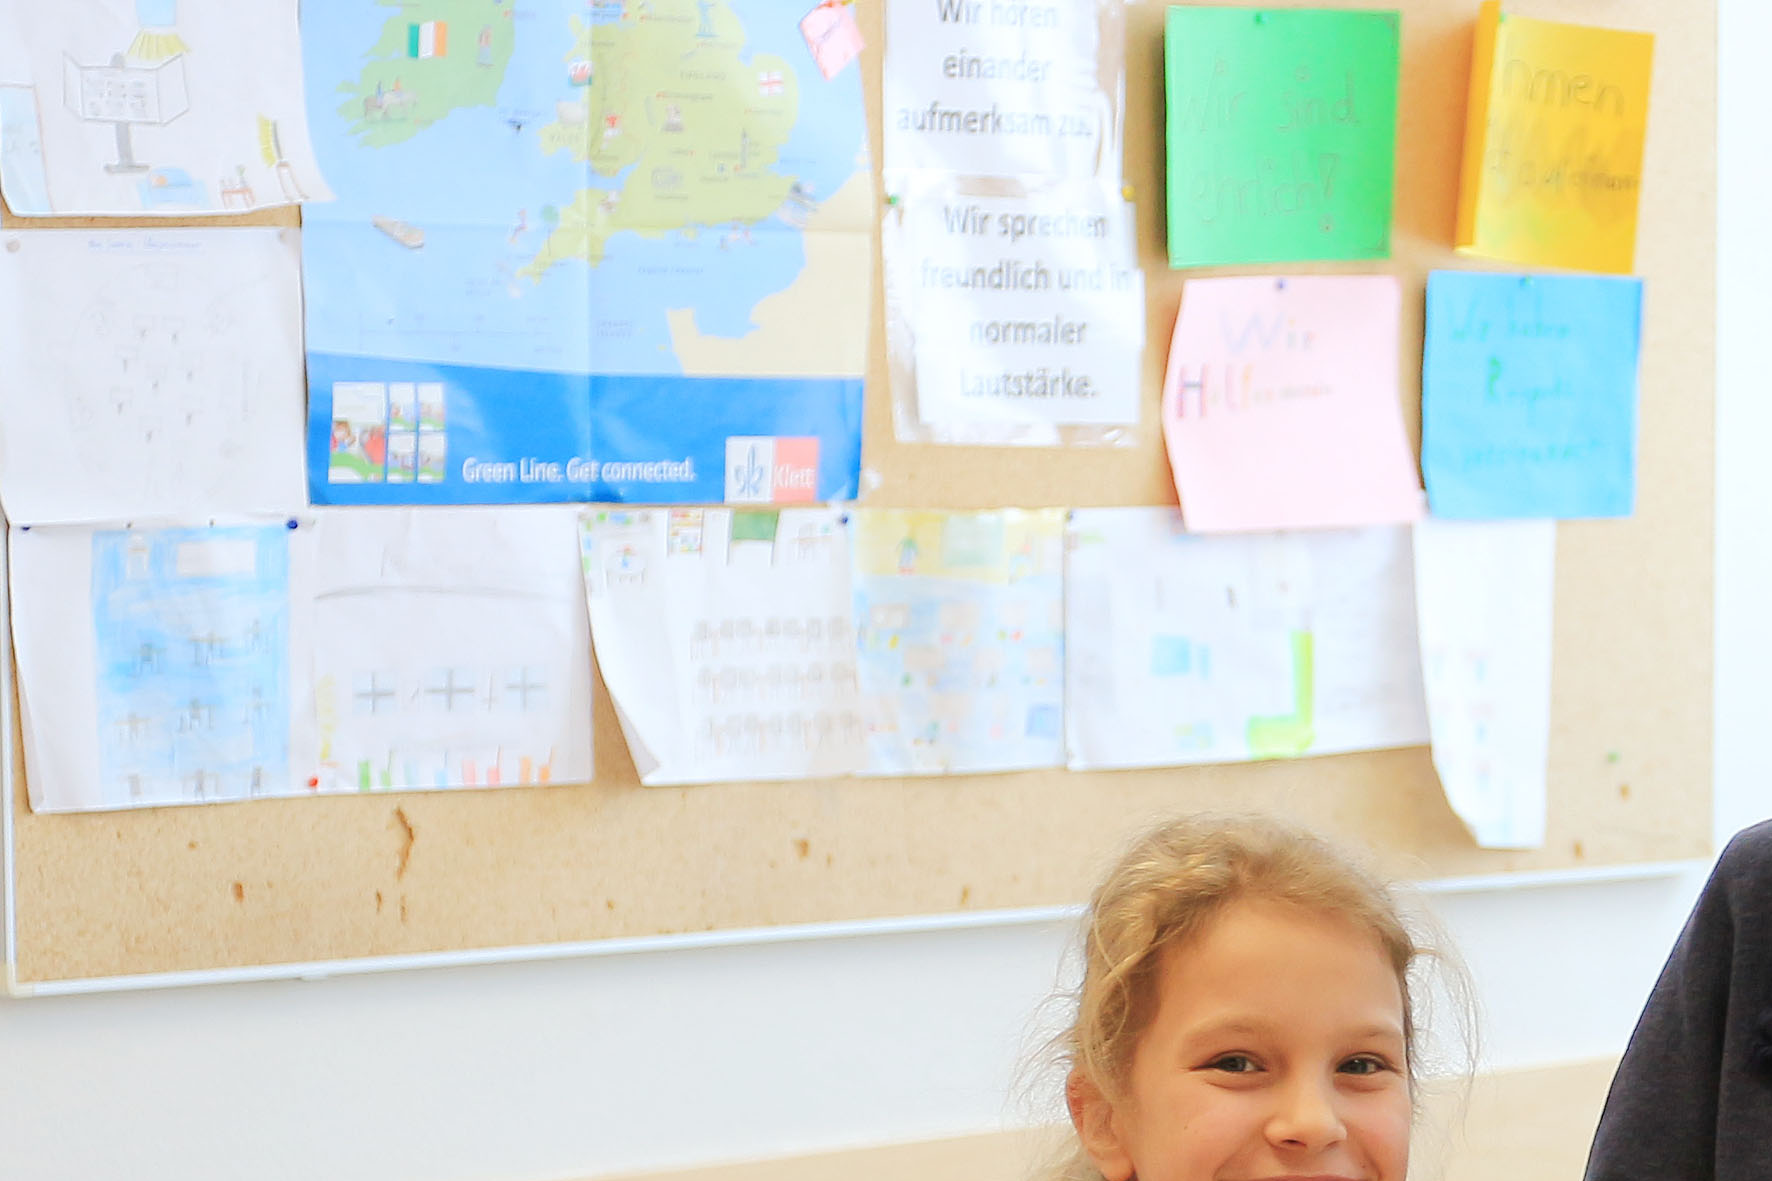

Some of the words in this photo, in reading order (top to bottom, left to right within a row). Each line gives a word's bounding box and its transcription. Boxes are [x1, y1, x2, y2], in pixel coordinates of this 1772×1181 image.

[943, 50, 1053, 81] einander
[897, 101, 1048, 136] aufmerksam
[944, 205, 991, 235] Wir
[999, 207, 1106, 242] sprechen
[921, 258, 1048, 290] freundlich
[1058, 262, 1105, 291] und
[970, 314, 1088, 345] normaler
[960, 367, 1099, 398] Lautstärke.
[462, 457, 516, 482] Green
[520, 457, 562, 482] Line.
[566, 457, 600, 482] Get
[601, 456, 697, 483] connected.
